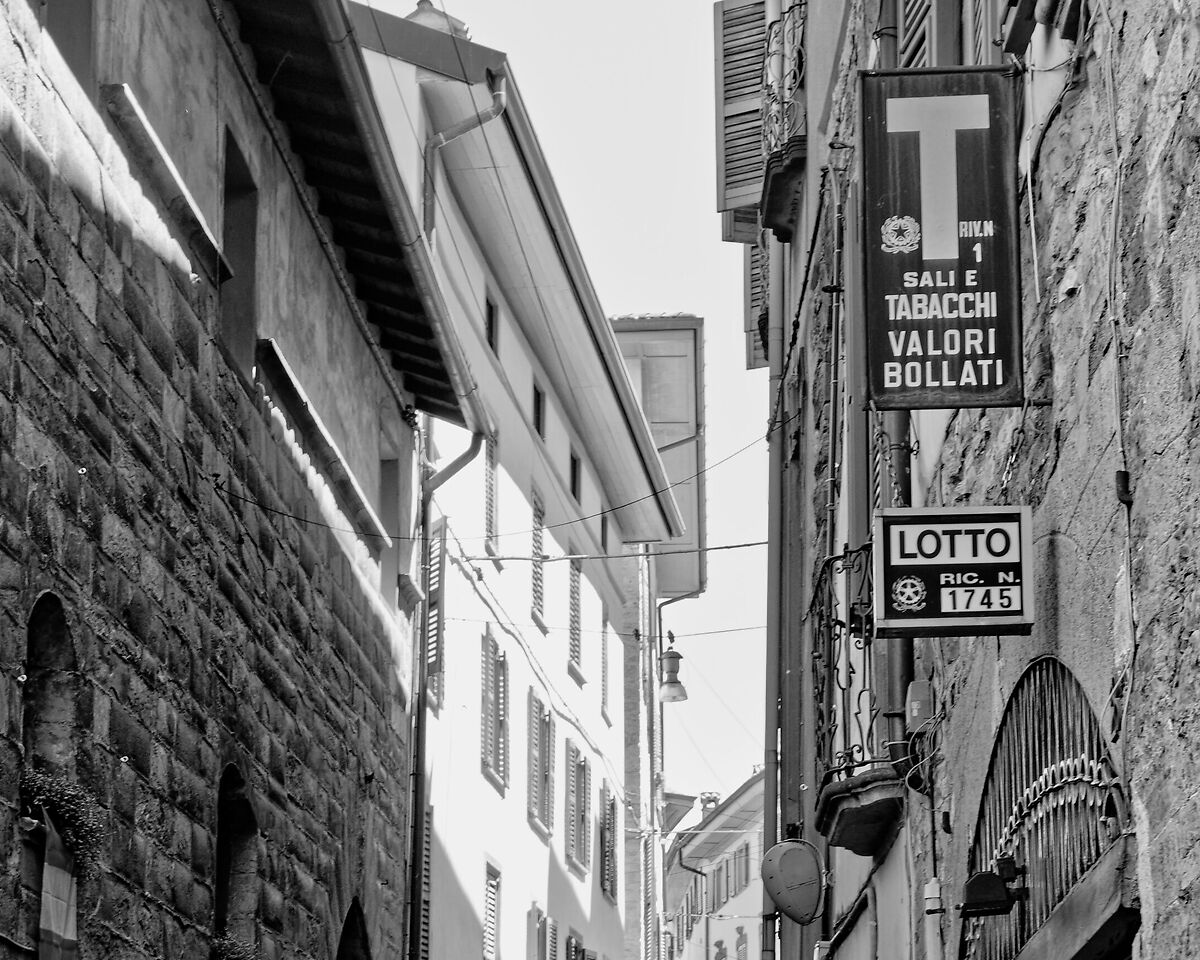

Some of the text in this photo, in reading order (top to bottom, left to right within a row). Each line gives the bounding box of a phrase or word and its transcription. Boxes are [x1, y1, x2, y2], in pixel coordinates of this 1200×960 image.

[886, 94, 990, 260] T
[972, 242, 983, 263] 1
[903, 269, 978, 288] SALI E
[885, 291, 997, 321] TABACCHI
[888, 328, 995, 357] VALORI
[883, 359, 1003, 388] BOLLATI
[899, 527, 1011, 559] LOTTO
[939, 571, 1021, 585] RIC. N.
[948, 588, 1012, 610] 1745
